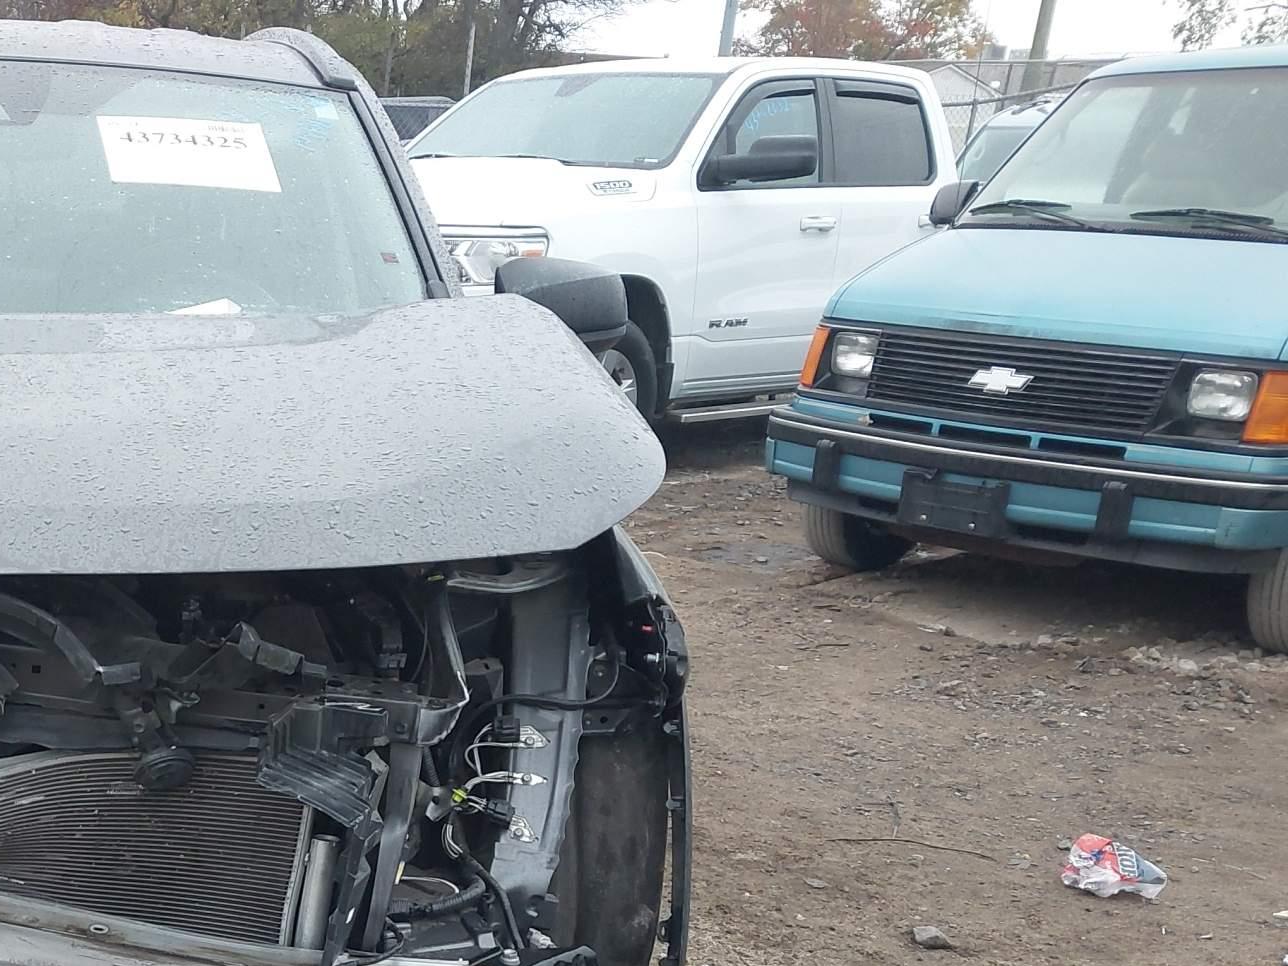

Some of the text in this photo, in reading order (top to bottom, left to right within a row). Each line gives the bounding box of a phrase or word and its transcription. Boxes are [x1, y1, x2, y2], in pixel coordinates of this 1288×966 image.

[119, 130, 248, 150] 43734325
[592, 180, 633, 190] 1500
[708, 318, 748, 329] RAM
